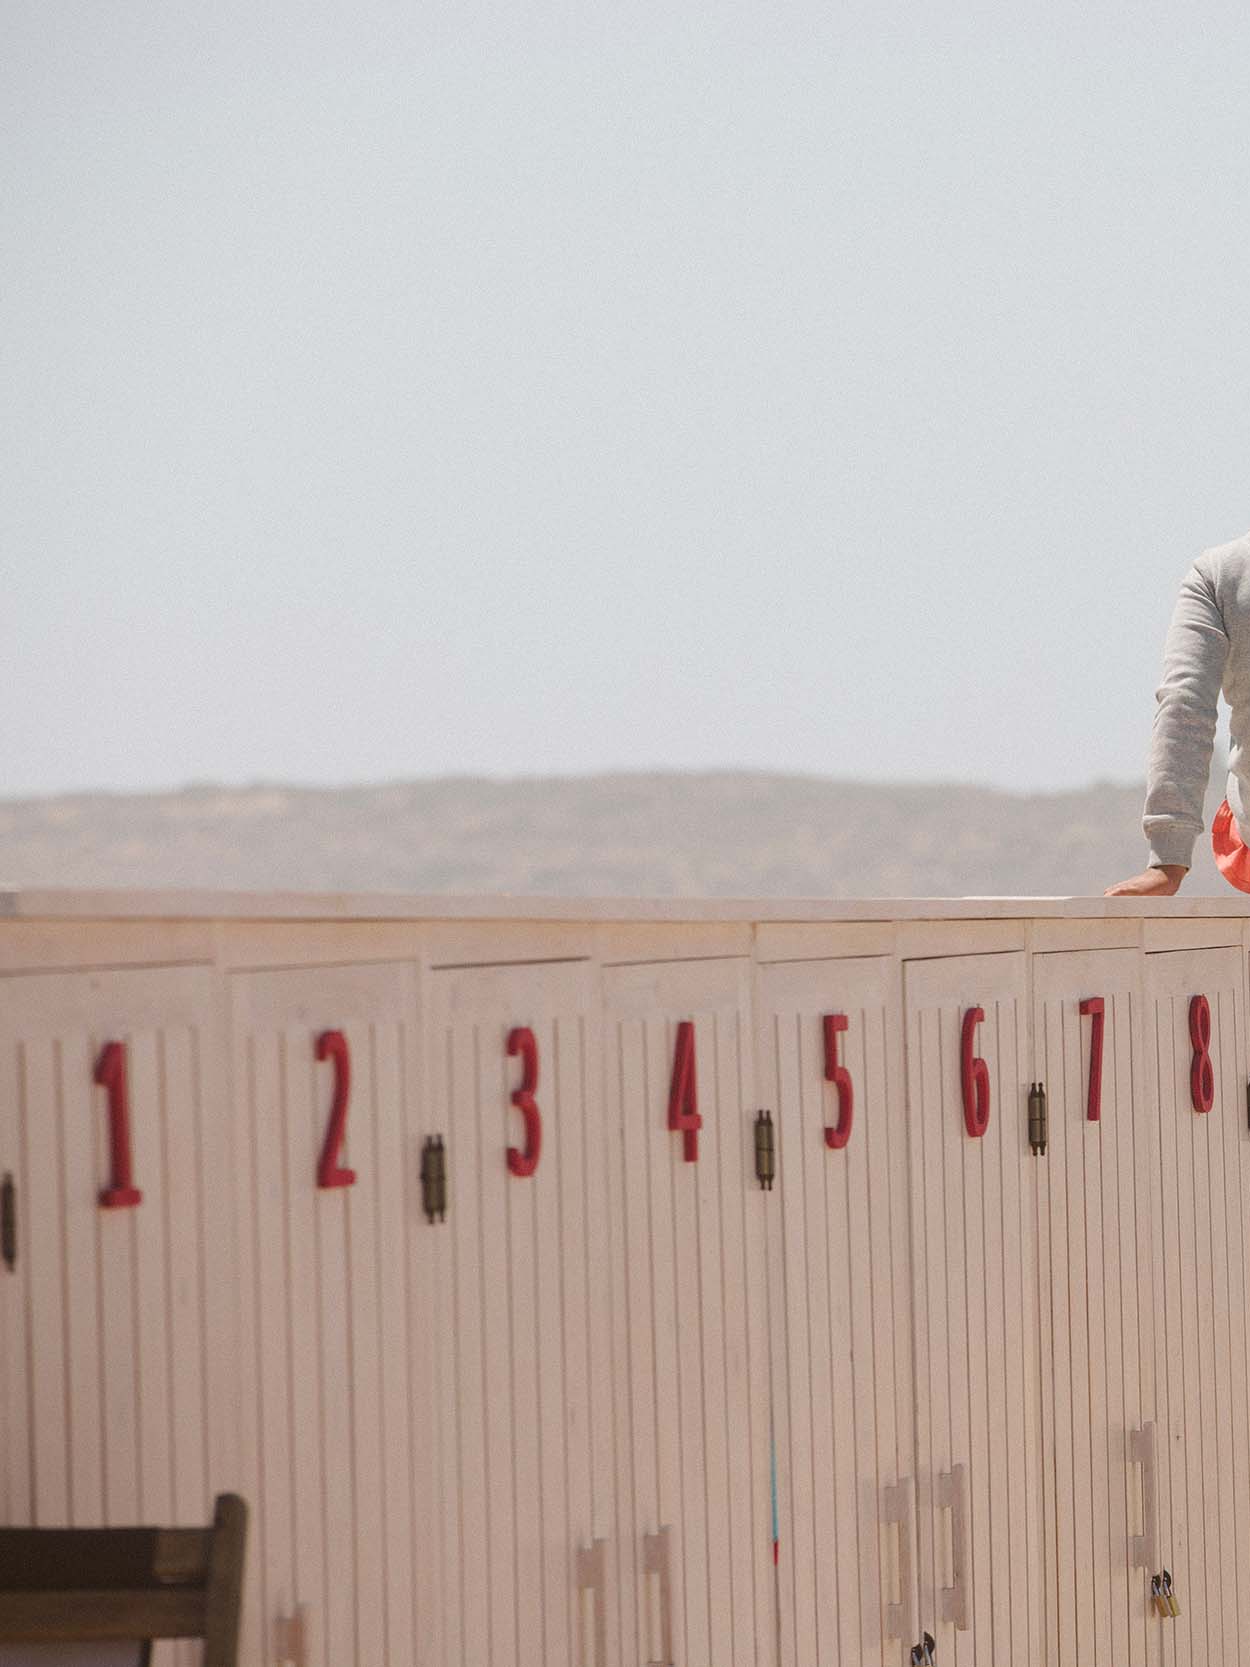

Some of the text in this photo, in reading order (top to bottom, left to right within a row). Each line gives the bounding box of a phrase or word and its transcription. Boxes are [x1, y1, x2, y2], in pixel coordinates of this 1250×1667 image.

[315, 1029, 357, 1190] 2
[505, 1026, 542, 1178] 3
[667, 1021, 703, 1163] 4
[823, 1014, 853, 1150] 5
[961, 1007, 991, 1139] 6
[1079, 997, 1105, 1121] 7
[1189, 994, 1215, 1114] 8
[94, 1041, 143, 1210] 1
